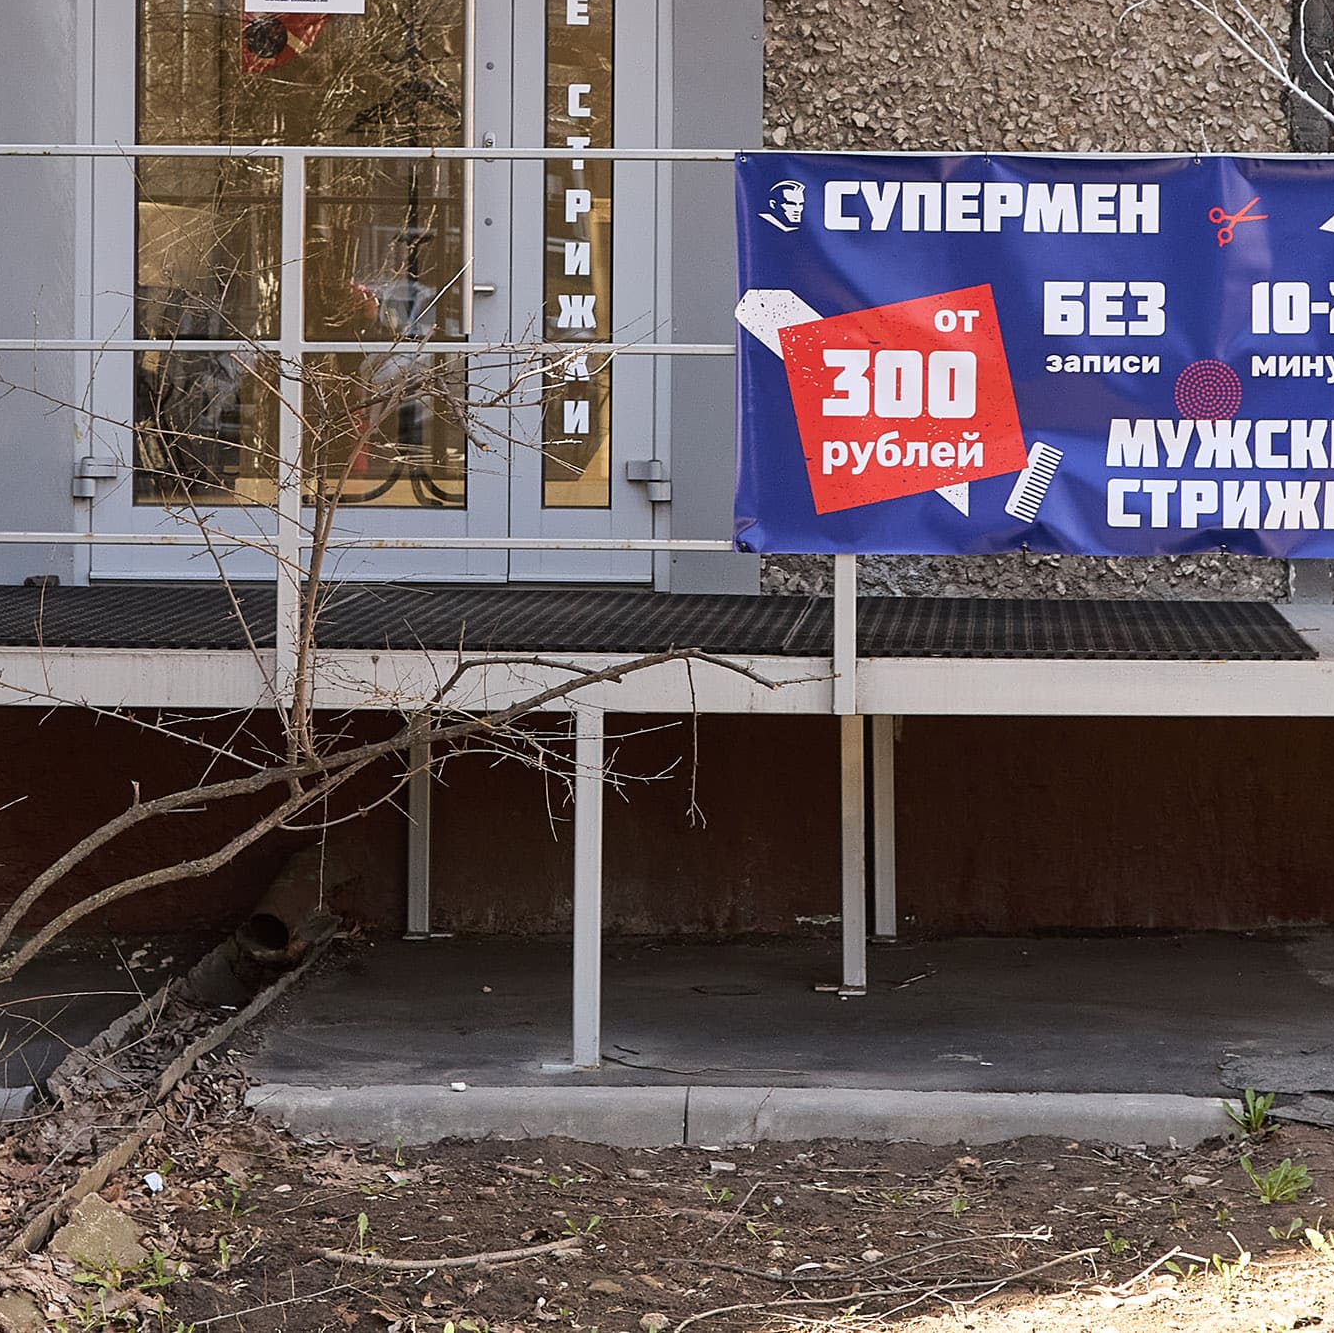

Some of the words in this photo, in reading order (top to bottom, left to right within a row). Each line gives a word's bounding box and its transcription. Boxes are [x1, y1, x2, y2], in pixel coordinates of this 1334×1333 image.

[823, 180, 1161, 234] СУПЕРМЕН
[933, 307, 980, 333] от
[1043, 280, 1166, 337] БЕЗ
[822, 348, 978, 420] 300
[1044, 352, 1161, 375] записи
[822, 432, 985, 476] рублей
